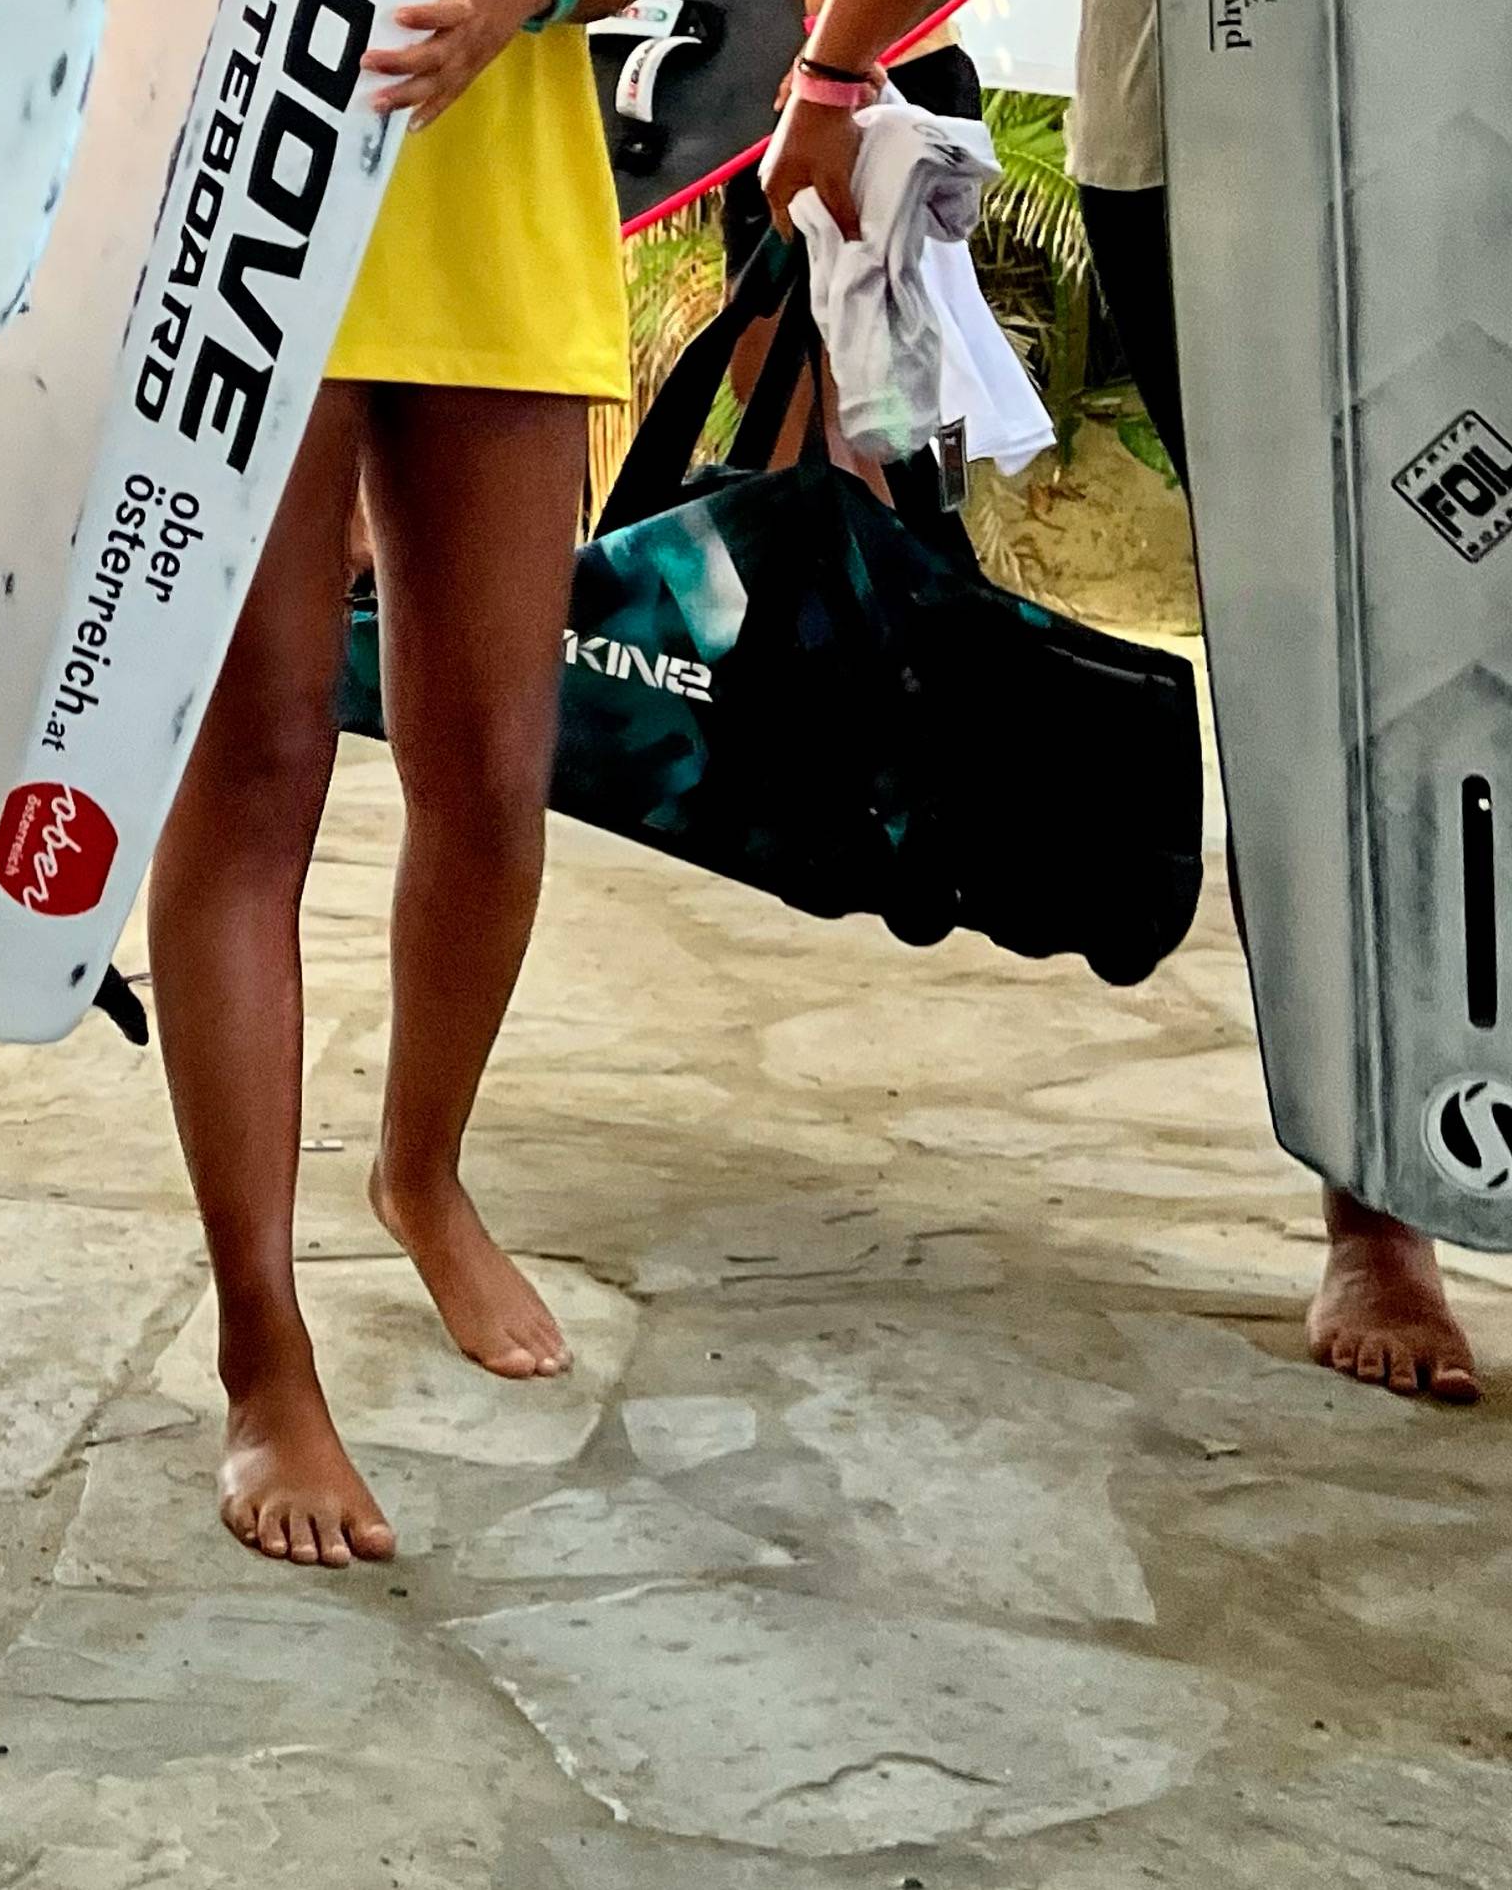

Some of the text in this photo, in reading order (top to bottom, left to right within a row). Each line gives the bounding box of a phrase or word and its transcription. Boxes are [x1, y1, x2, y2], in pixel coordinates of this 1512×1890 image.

[144, 491, 204, 603] ober
[42, 473, 166, 751] österreich.at
[2, 794, 40, 877] österreich
[22, 784, 82, 910] ober
